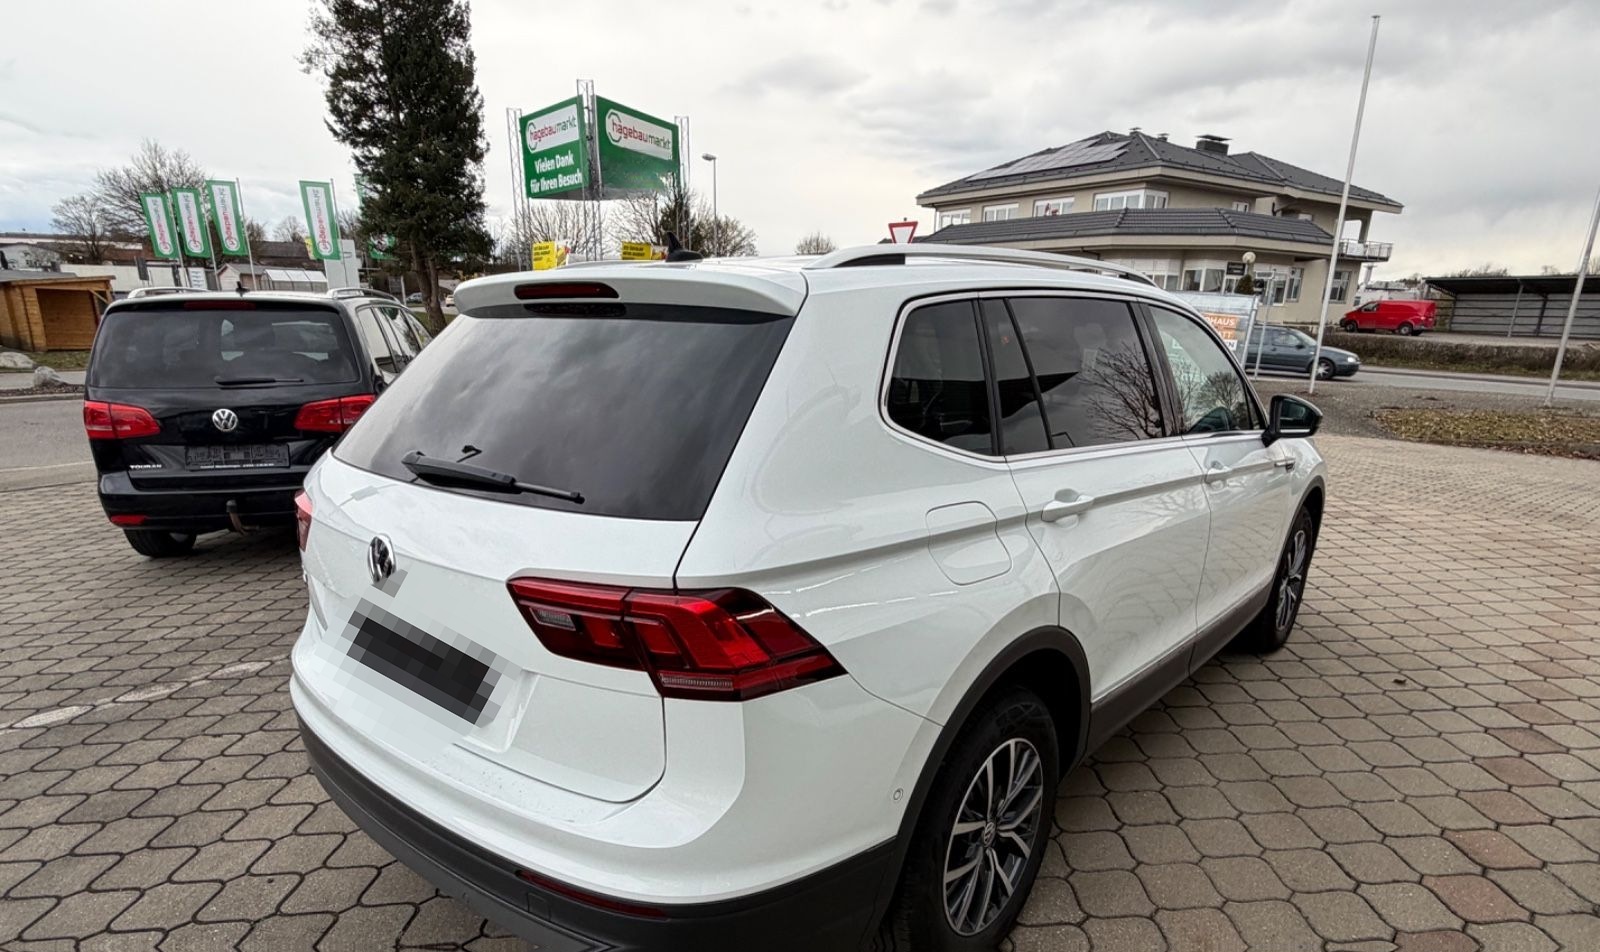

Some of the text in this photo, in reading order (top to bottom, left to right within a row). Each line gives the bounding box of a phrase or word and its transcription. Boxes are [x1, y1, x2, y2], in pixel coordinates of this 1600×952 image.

[529, 114, 577, 142] hagebaumarkt
[612, 120, 671, 150] hagebaumarkt
[534, 150, 575, 174] Vielen Dank
[530, 168, 582, 193] für Ihren Besuch
